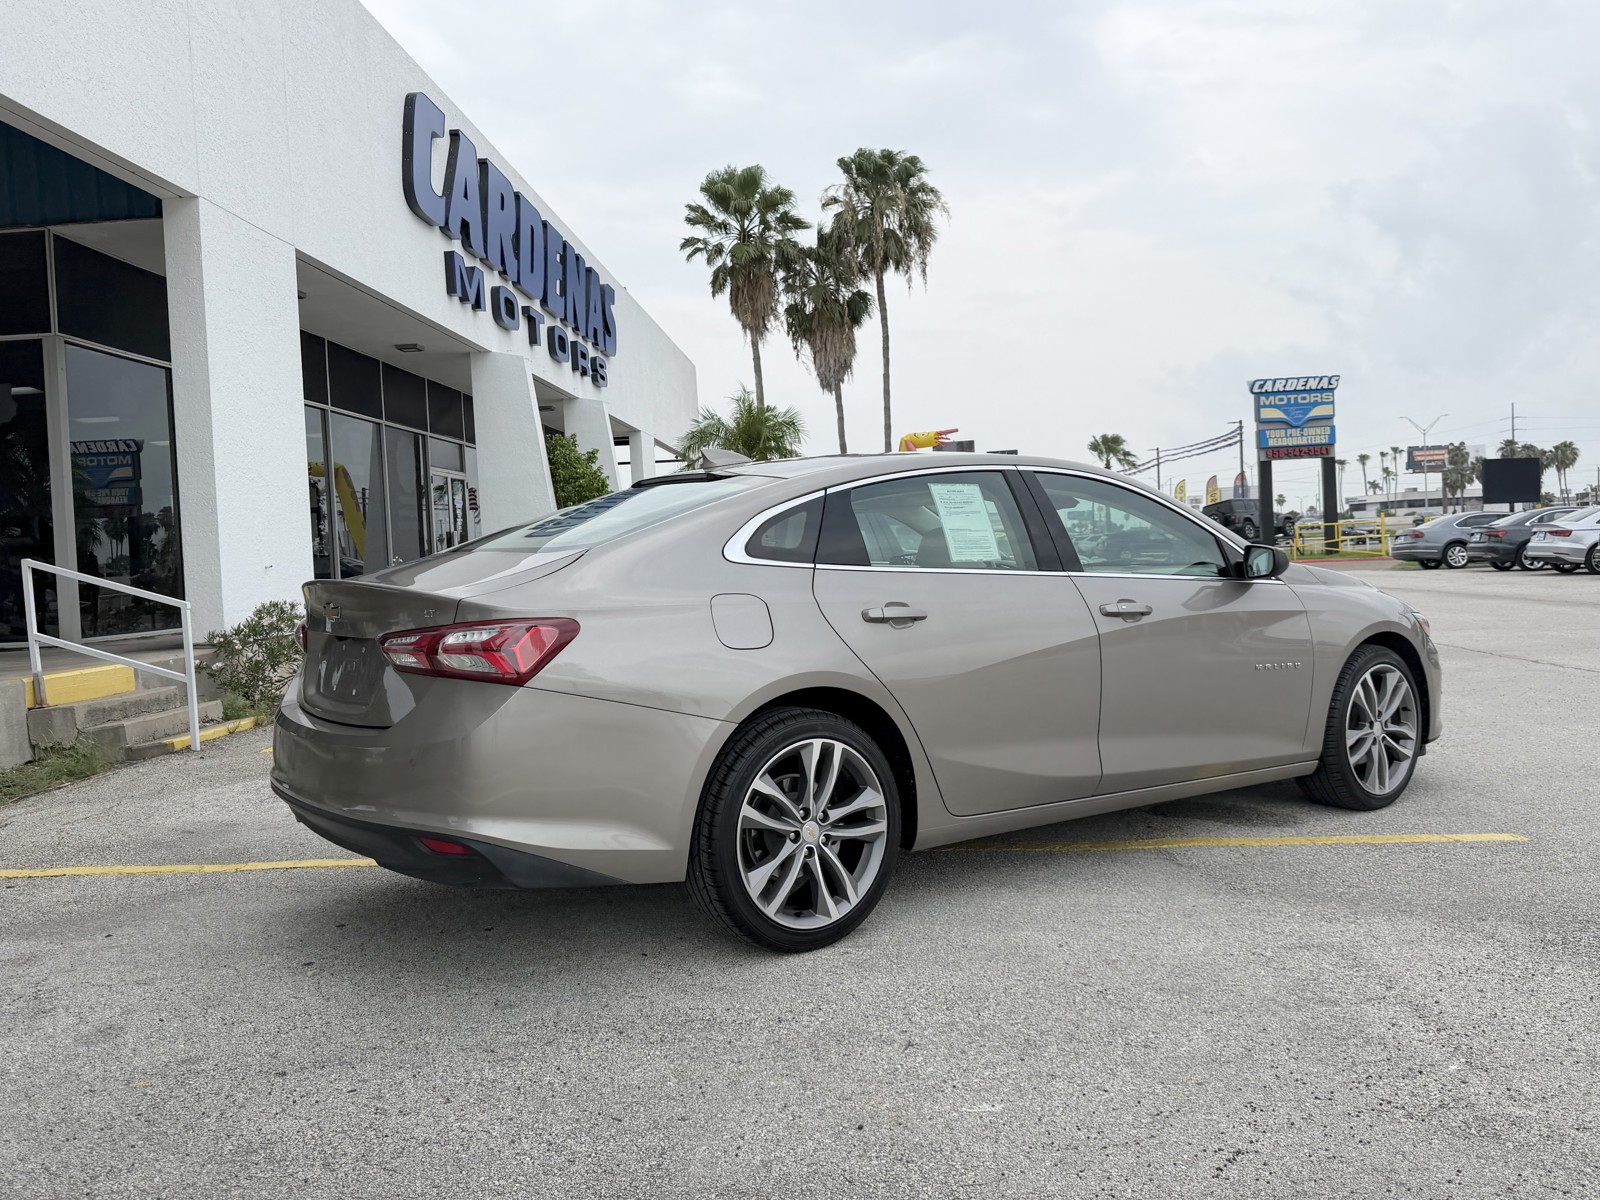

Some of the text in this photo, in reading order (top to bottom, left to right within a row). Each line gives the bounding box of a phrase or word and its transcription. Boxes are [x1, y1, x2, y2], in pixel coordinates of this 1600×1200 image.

[402, 91, 616, 358] CARDENAS
[444, 250, 608, 388] MOTORS
[1252, 375, 1340, 393] CARDENAS
[1260, 392, 1333, 405] MOTORS
[1265, 427, 1331, 438] YOUR PRE-OWNED
[424, 609, 436, 618] LT
